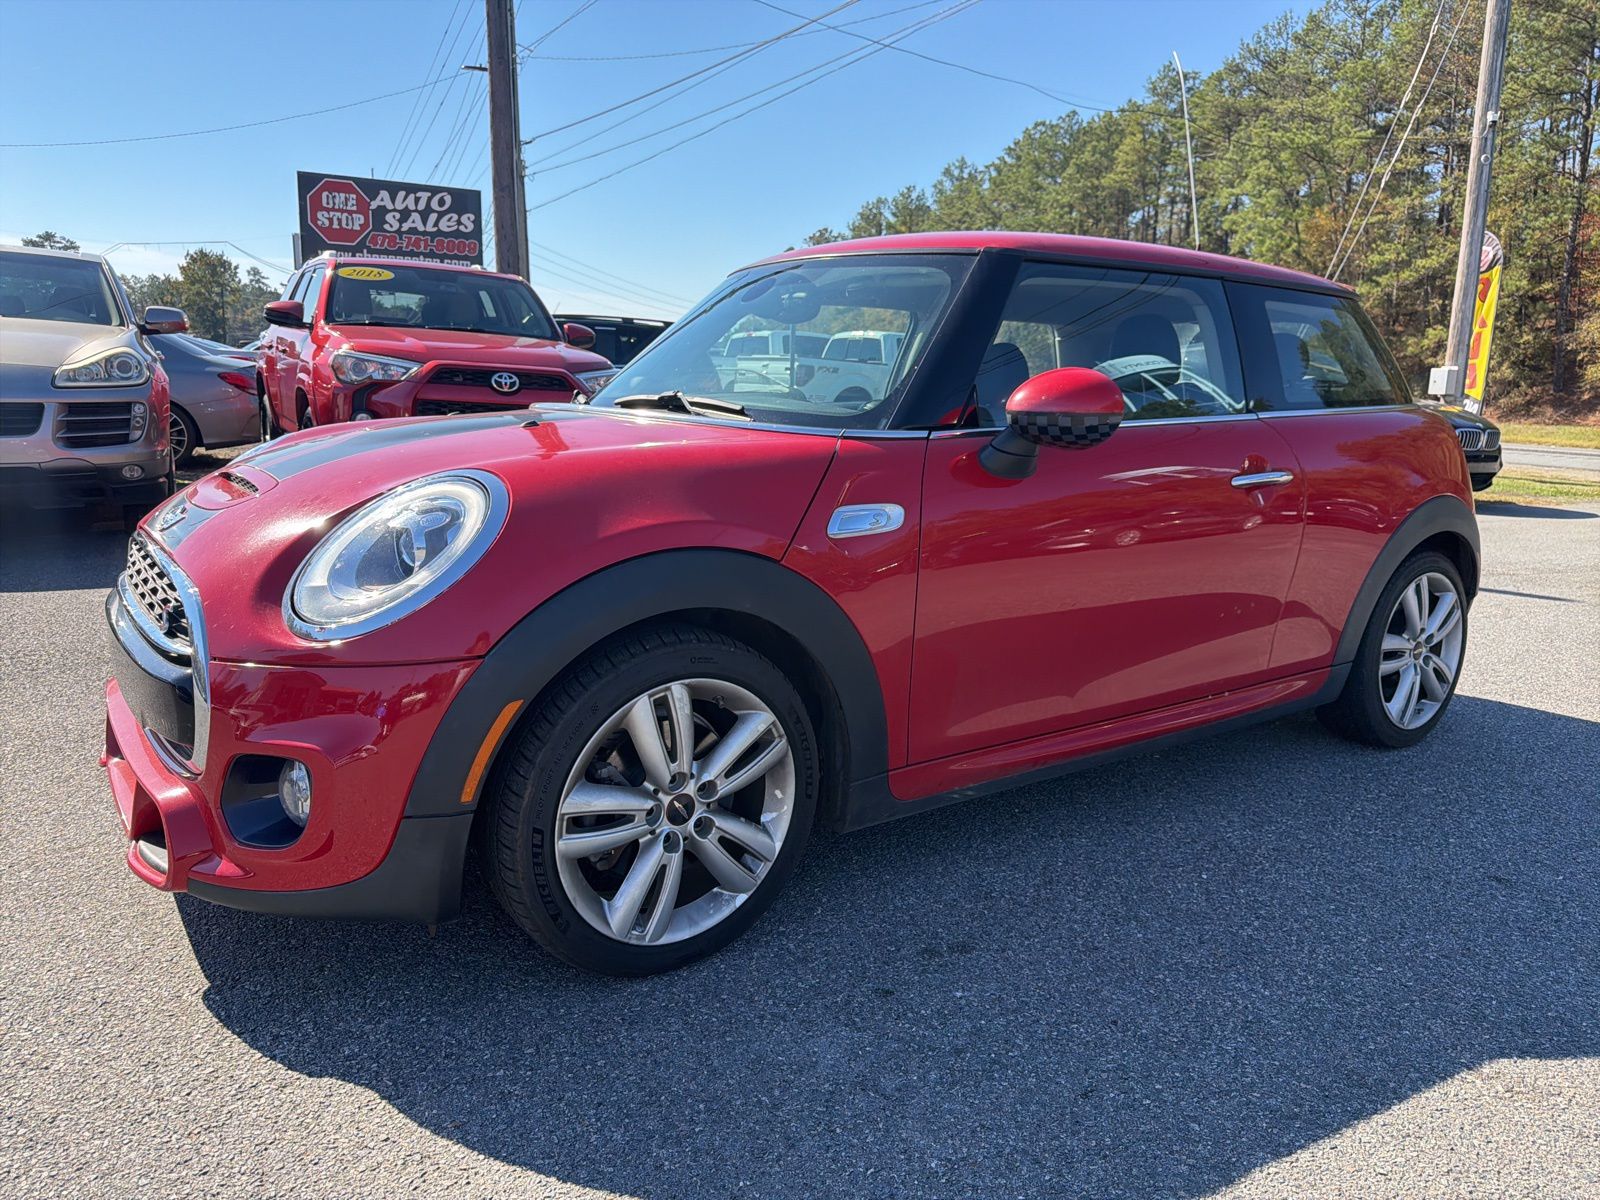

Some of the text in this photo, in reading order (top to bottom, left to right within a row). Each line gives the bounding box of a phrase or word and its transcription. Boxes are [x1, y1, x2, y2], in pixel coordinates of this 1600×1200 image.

[321, 191, 357, 211] ONE
[369, 189, 452, 212] AUTO
[316, 211, 365, 231] STOP
[346, 269, 385, 279] 2018
